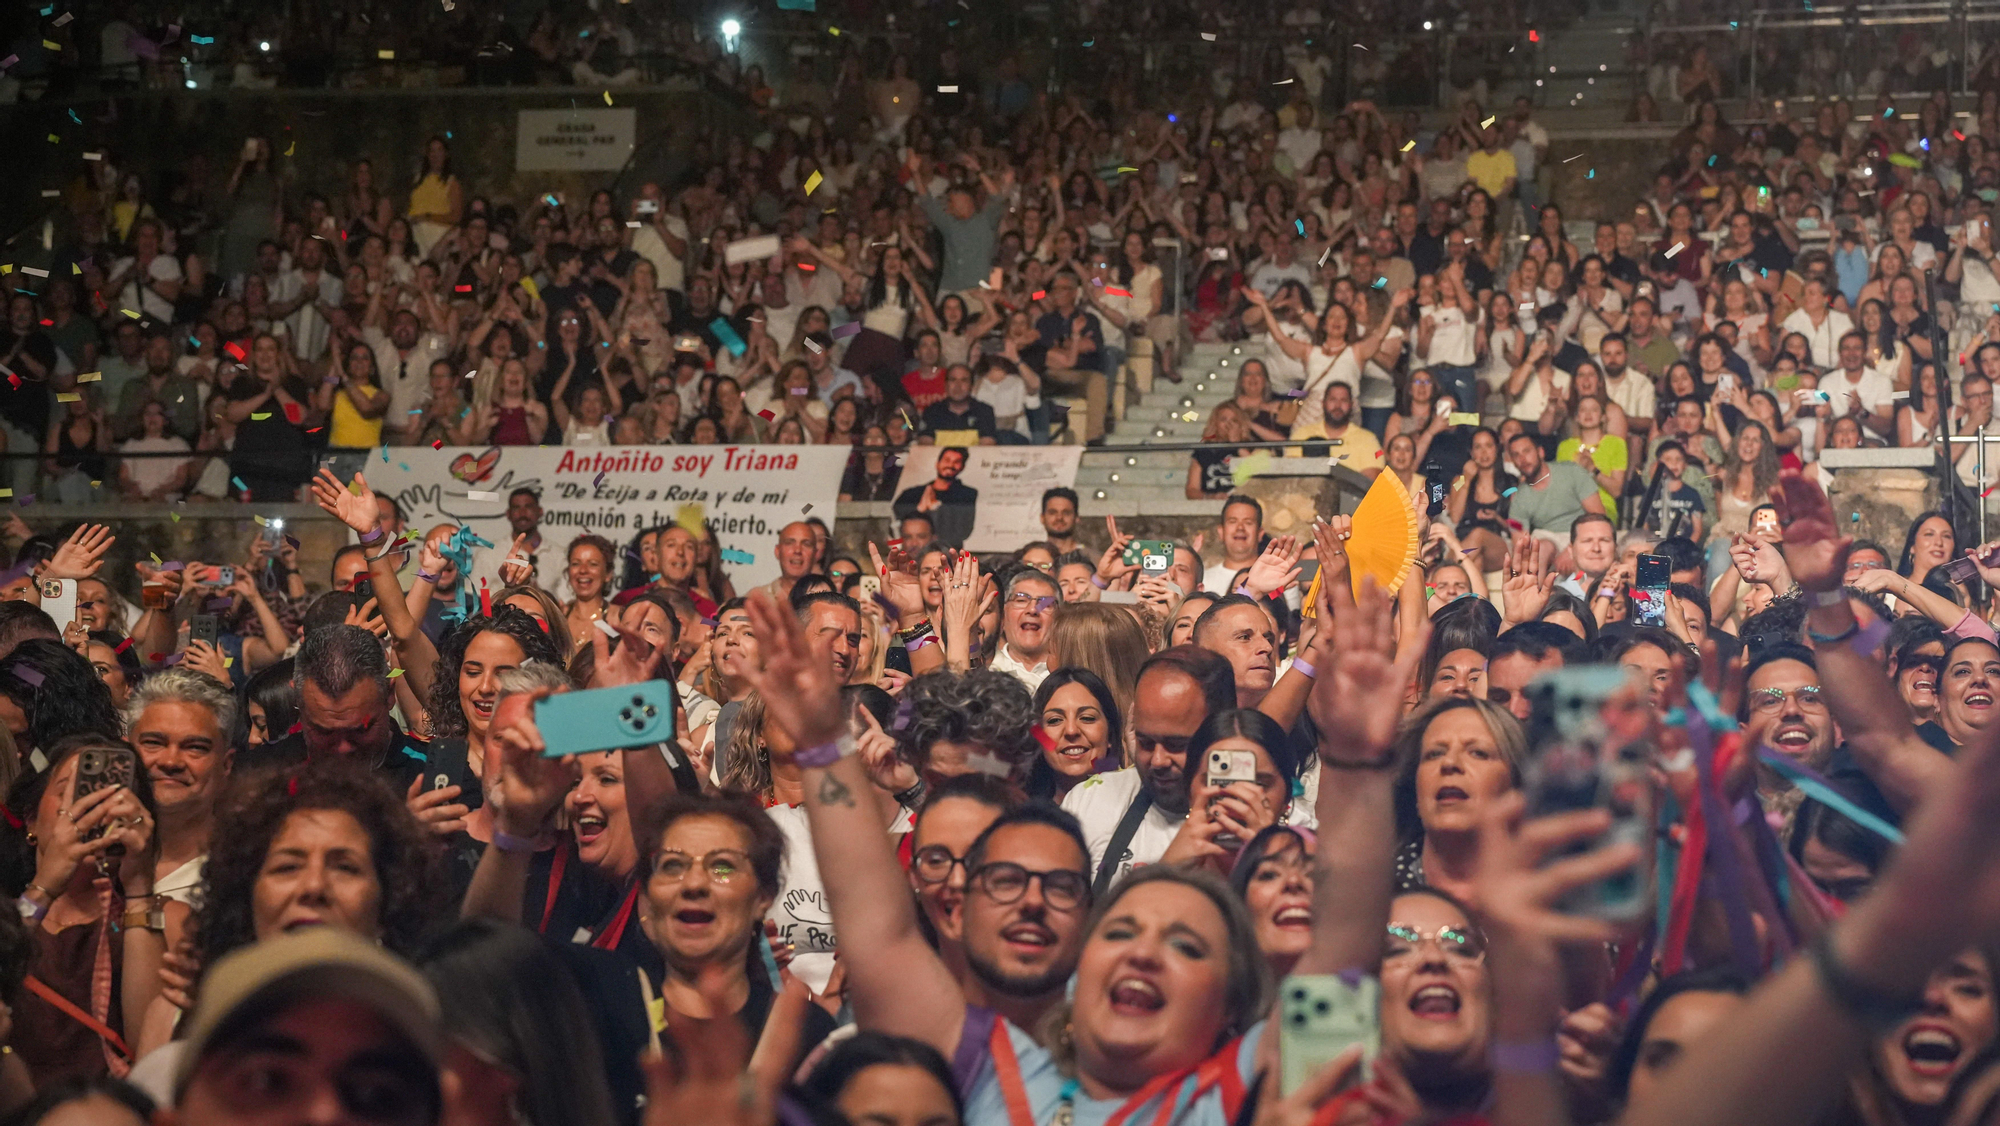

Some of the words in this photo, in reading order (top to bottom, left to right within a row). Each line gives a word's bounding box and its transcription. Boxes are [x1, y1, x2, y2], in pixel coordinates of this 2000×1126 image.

[555, 449, 664, 474] Antoñito
[672, 454, 714, 478] soy
[724, 446, 799, 472] Triana
[555, 482, 587, 499] "De
[646, 489, 657, 501] a
[664, 485, 708, 501] Rota
[715, 491, 727, 509] y
[732, 486, 756, 503] de
[762, 489, 789, 504] mi
[537, 506, 626, 528] omunión
[633, 514, 643, 529] a
